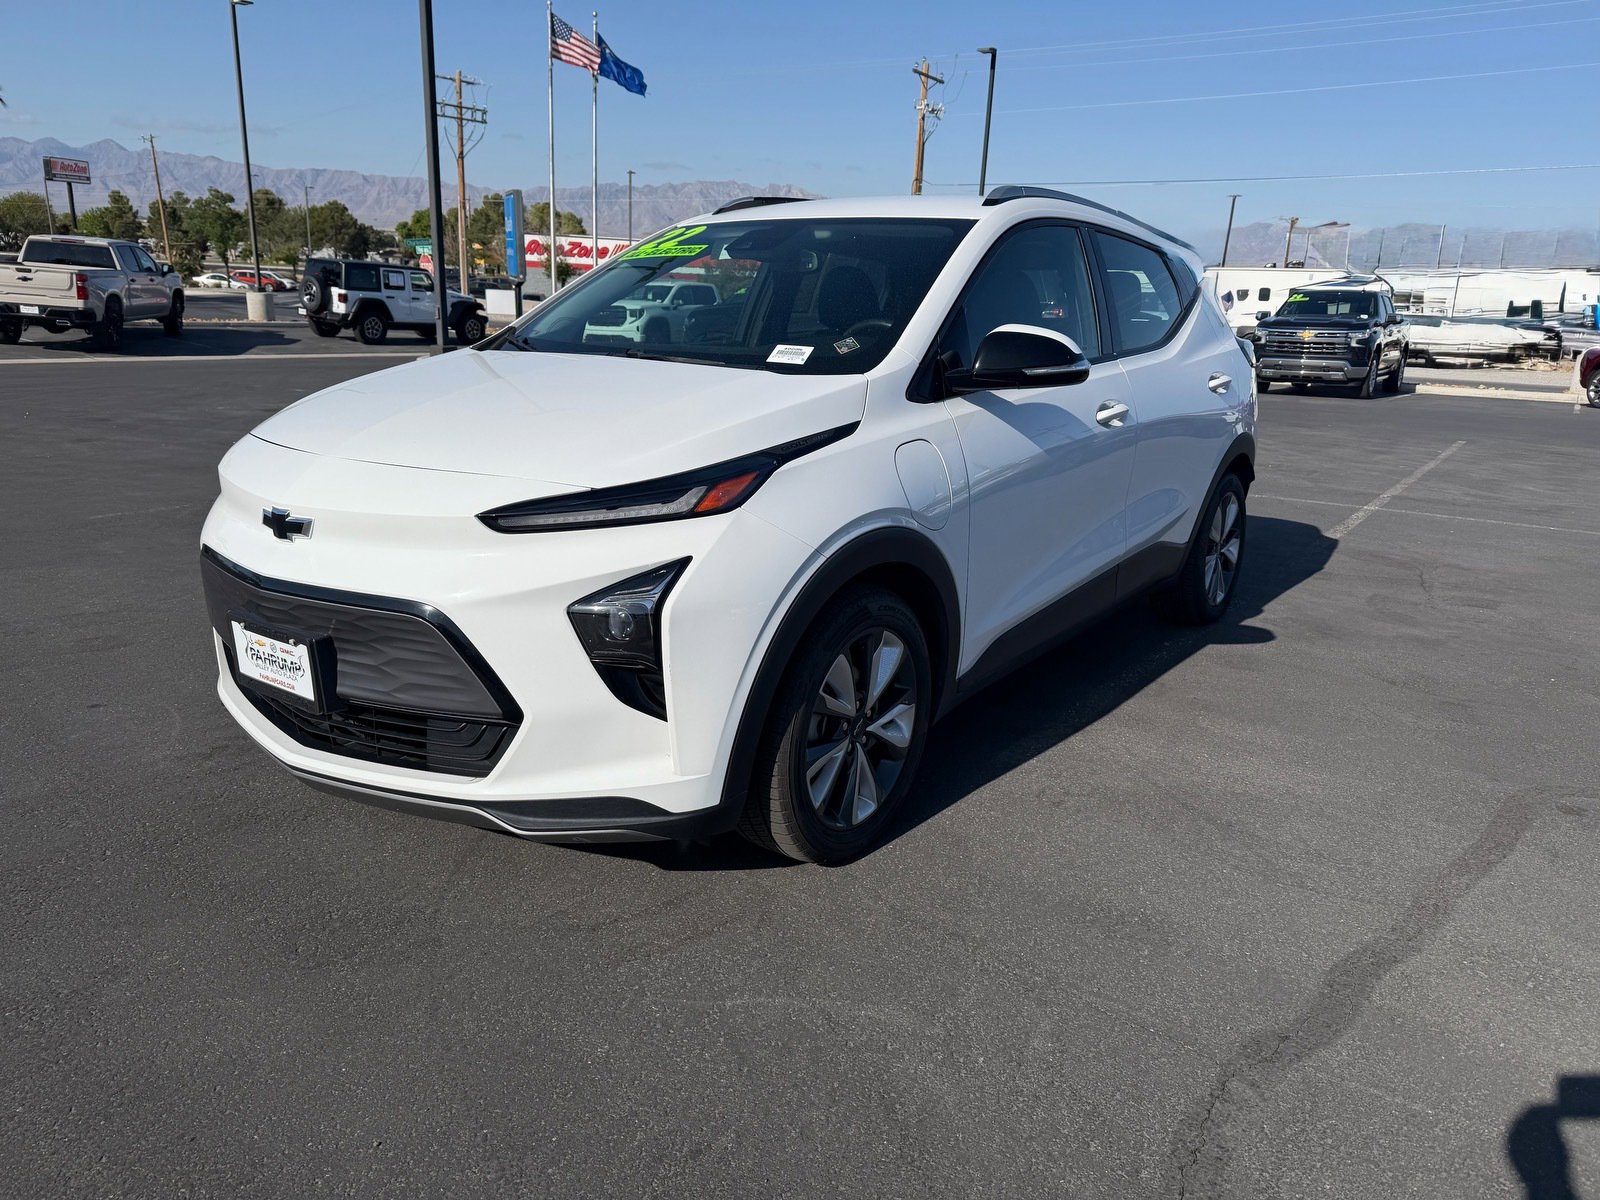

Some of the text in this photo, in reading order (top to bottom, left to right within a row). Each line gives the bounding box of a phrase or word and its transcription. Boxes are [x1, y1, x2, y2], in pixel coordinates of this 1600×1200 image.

[60, 161, 87, 174] AutoZone
[525, 239, 610, 259] AuoZone
[280, 647, 295, 657] GMC
[250, 647, 301, 673] PAHRUMP
[271, 667, 283, 676] AUTO
[283, 671, 298, 682] PLAZA
